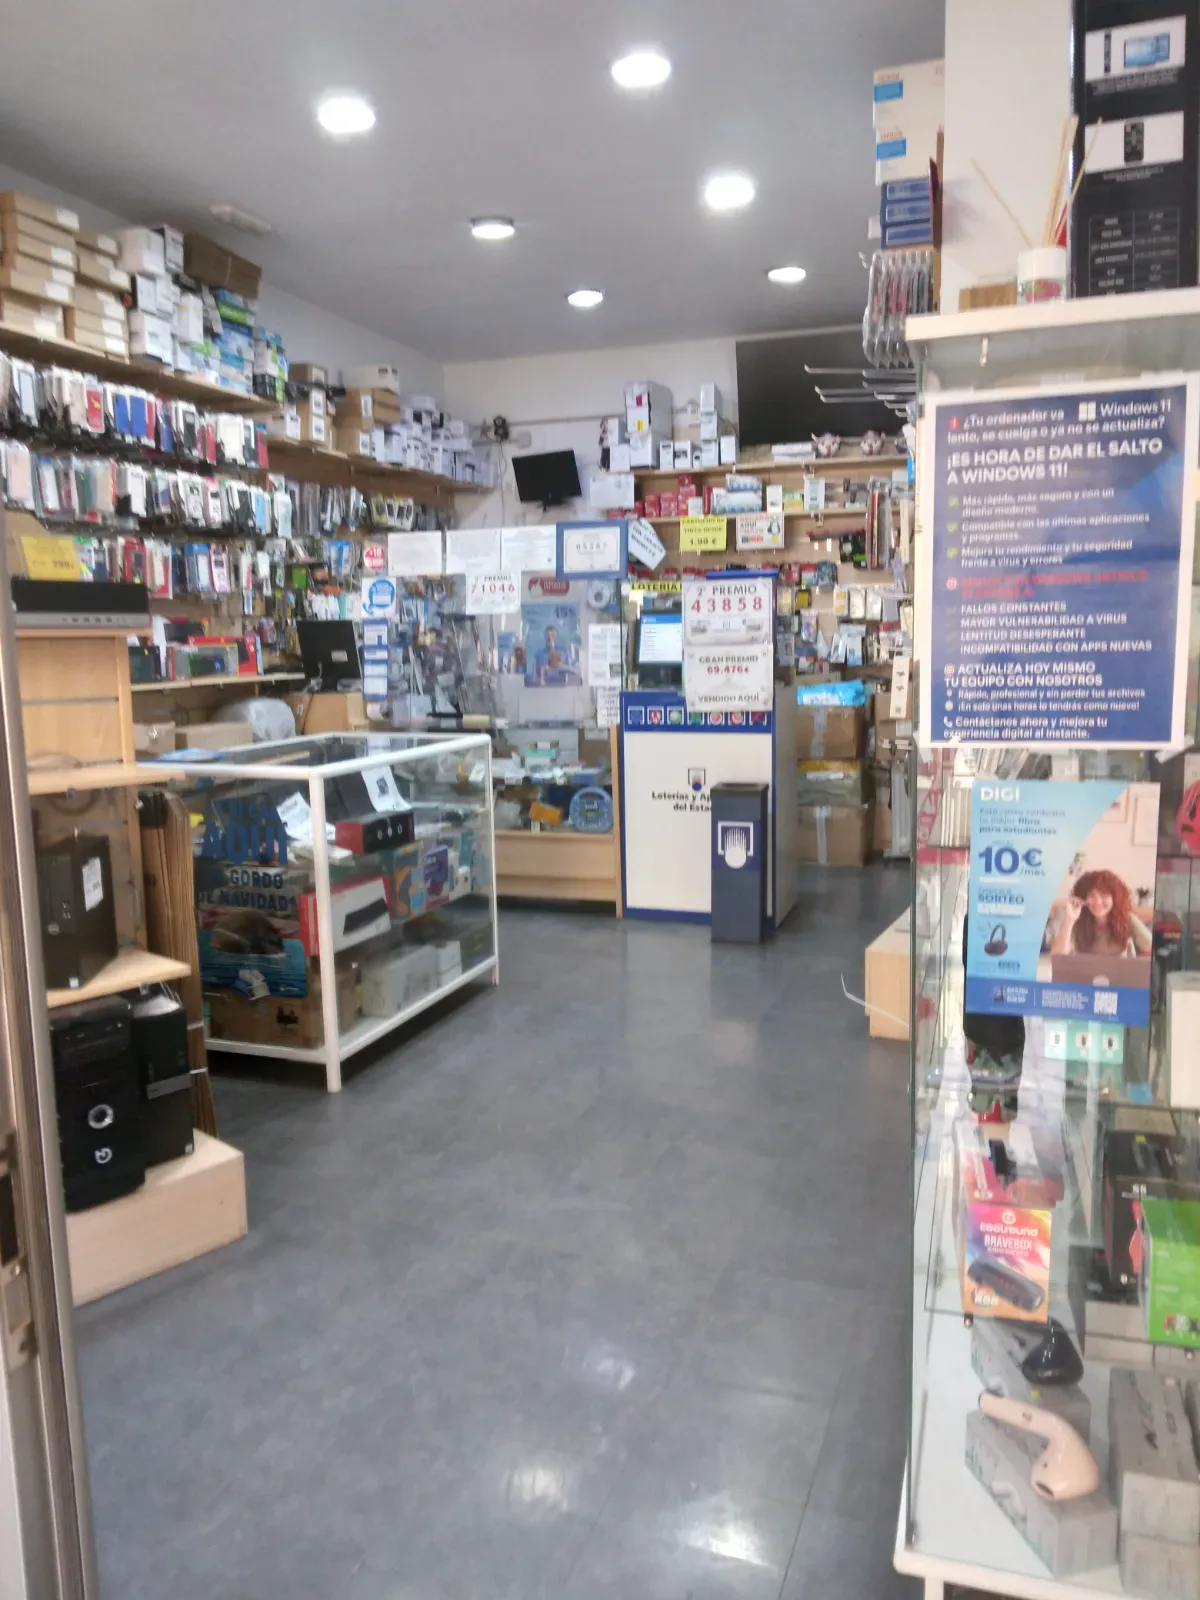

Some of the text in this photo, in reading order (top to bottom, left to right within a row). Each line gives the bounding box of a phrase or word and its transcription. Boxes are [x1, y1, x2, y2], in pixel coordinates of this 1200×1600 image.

[1100, 398, 1171, 417] Windows 11
[986, 408, 1047, 426] ordenador
[1050, 408, 1064, 421] va
[947, 431, 979, 445] lento,
[982, 430, 996, 442] se
[998, 426, 1038, 441] cuelga
[1051, 424, 1065, 439] ya
[1067, 423, 1083, 435] no
[1086, 422, 1099, 434] se
[1102, 415, 1165, 433] actualiza?
[947, 437, 1163, 471] ¡ES HORA DE DAR EL SALTO
[947, 461, 1068, 486] A WINDOWS 11!
[1102, 487, 1115, 499] un
[1084, 539, 1133, 554] seguridad
[712, 584, 758, 596] PREMIO
[690, 596, 763, 613] 43858
[961, 600, 1067, 615] FALLOS CONSTANTES
[960, 611, 1128, 629] MAYOR VULNERABILIDAD A VIRUS
[961, 627, 1086, 642] LENTITUD DESESPERANTE
[960, 639, 1153, 656] INCOMPATIBILIDAD CON APPS NUEVAS
[725, 654, 759, 663] PREMIO
[957, 660, 1096, 676] ACTUALIZA HOY MISMO
[944, 673, 1104, 688] TU EQUIPO CON NOSOTROS
[990, 687, 1038, 701] profesional
[1046, 688, 1060, 699] sin
[1060, 687, 1090, 701] perder
[1091, 688, 1106, 699] tus
[1107, 686, 1146, 699] archivos
[1013, 700, 1038, 712] horas
[1083, 701, 1109, 712] como
[1109, 699, 1140, 712] nuevo!
[955, 714, 1018, 728] Contáctanos
[1019, 714, 1049, 727] ahora
[1059, 715, 1095, 729] mejora
[1096, 716, 1108, 727] tu
[1001, 726, 1033, 740] digital
[1034, 727, 1044, 739] al
[980, 786, 1020, 802] DIGI
[673, 802, 711, 813] del Esta
[979, 826, 1057, 837] para estudiantes
[230, 867, 284, 890] GORDO
[978, 892, 1025, 905] SORTEO
[984, 1234, 1033, 1251] BRAVEBOX
